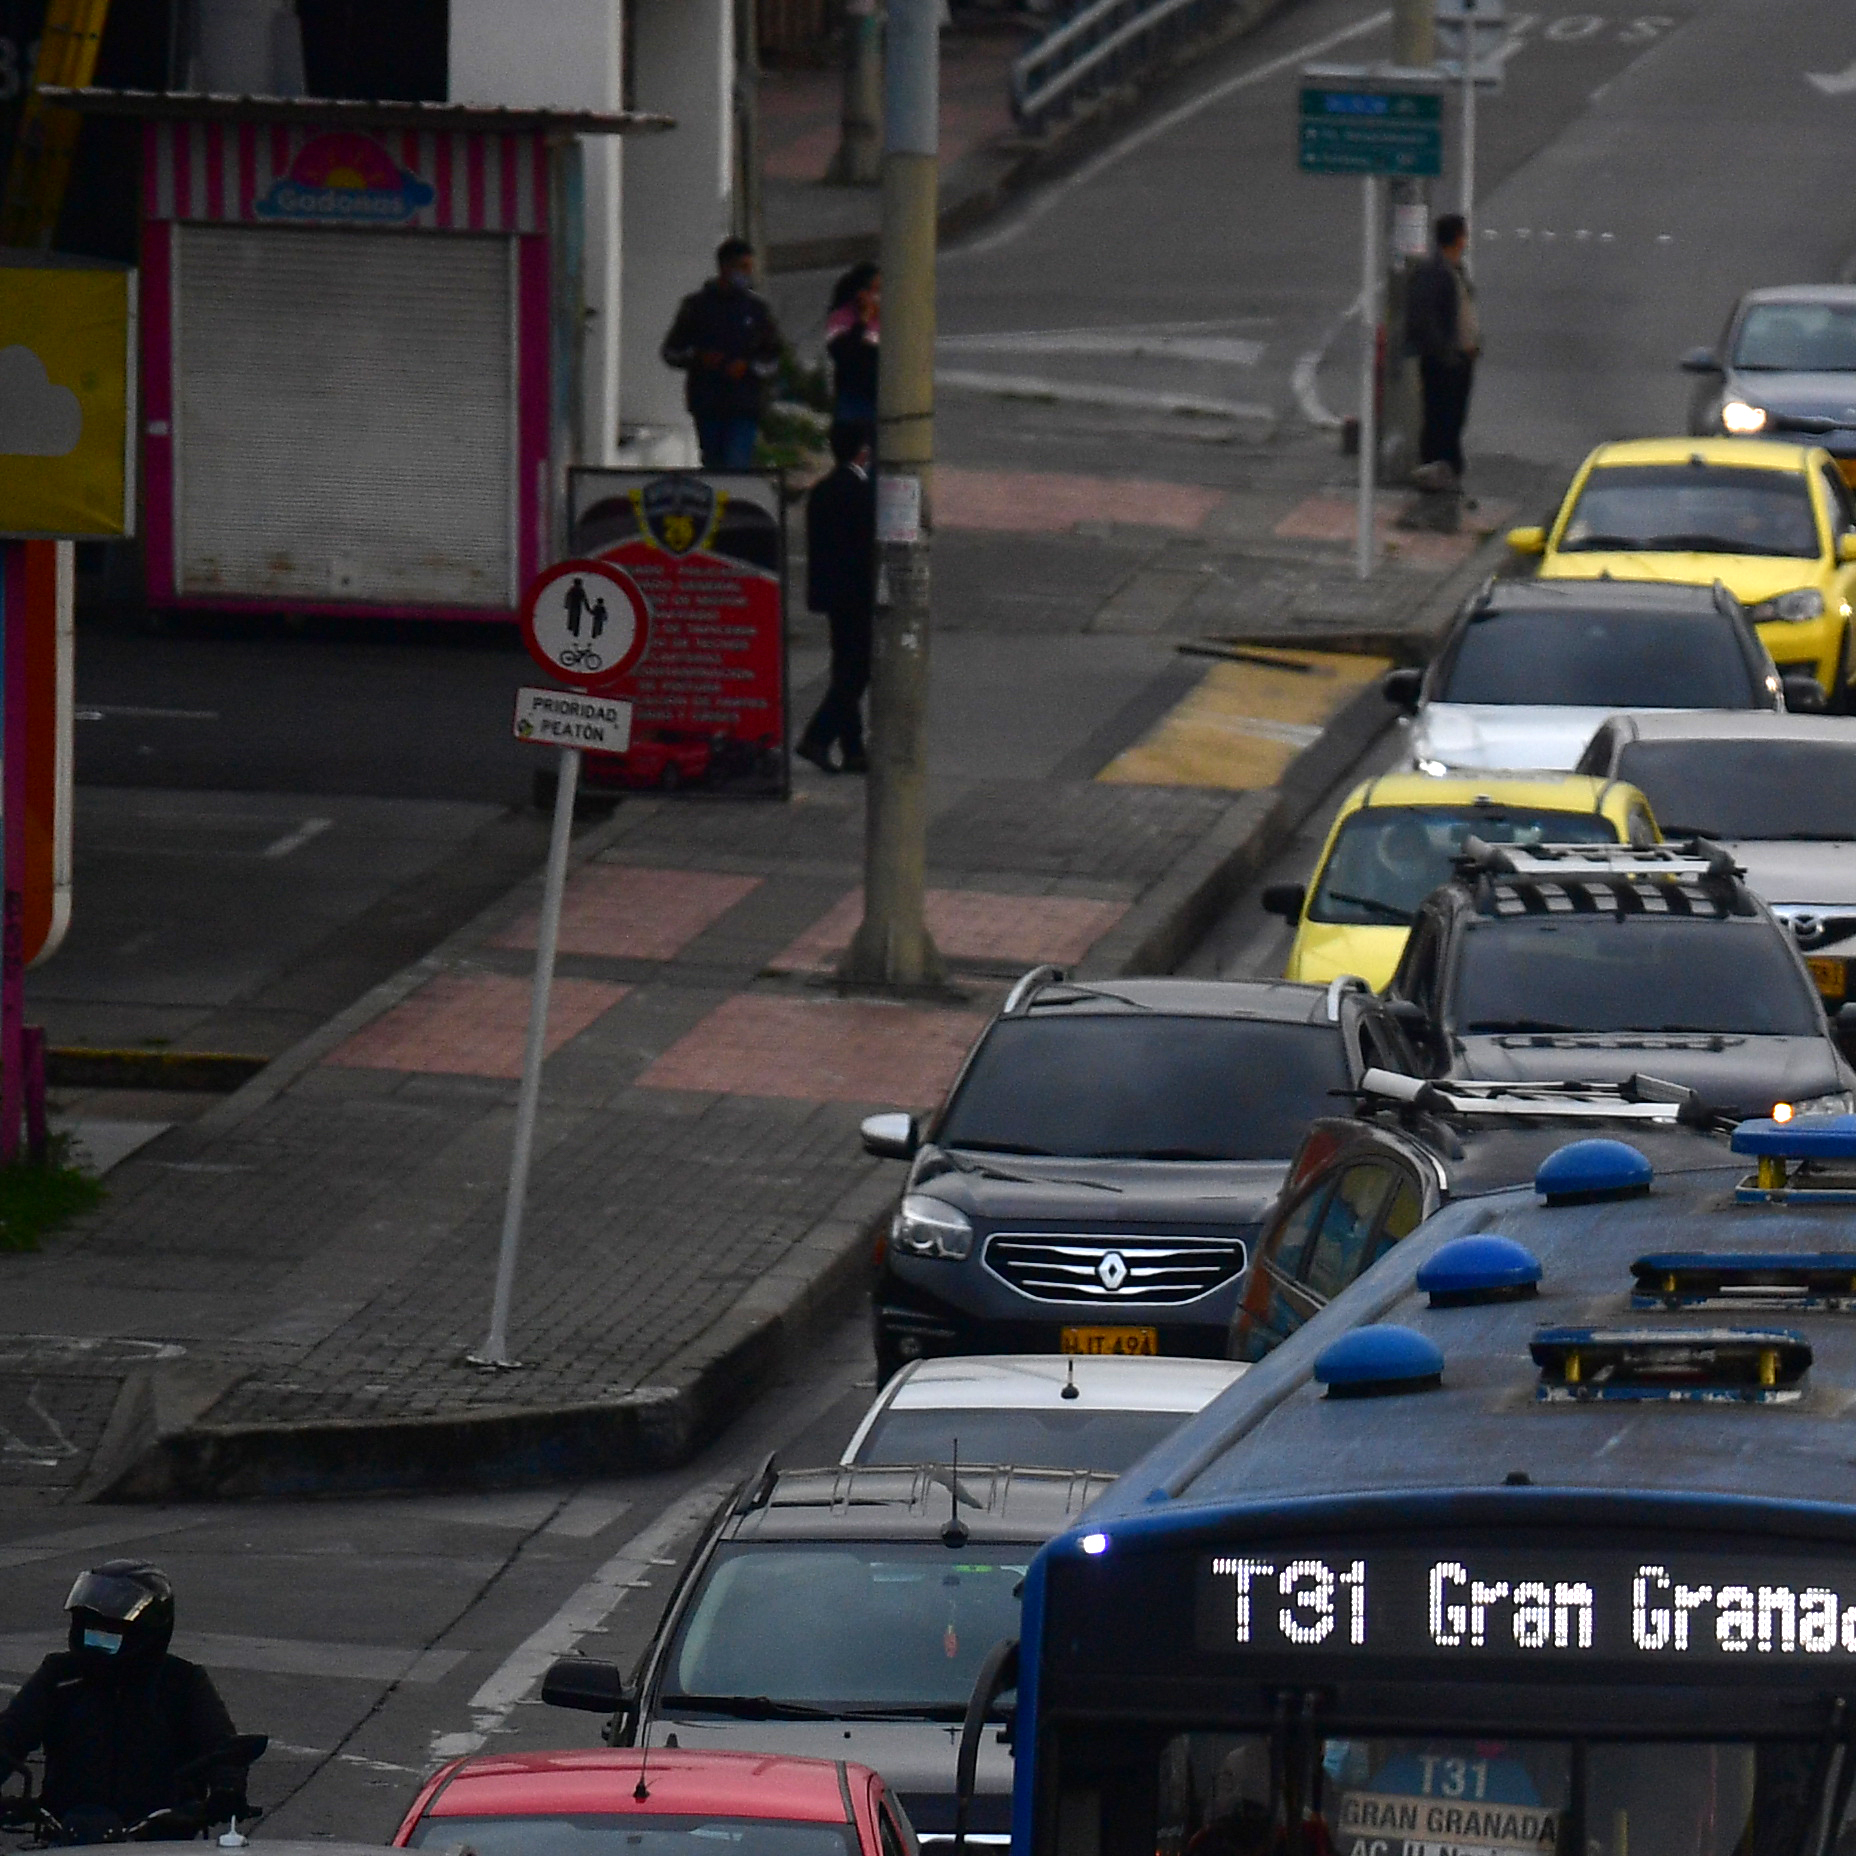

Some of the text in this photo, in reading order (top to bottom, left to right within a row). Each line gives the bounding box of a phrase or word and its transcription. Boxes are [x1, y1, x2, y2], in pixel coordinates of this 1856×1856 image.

[532, 696, 618, 722] PRIORIDAD
[1212, 1558, 1365, 1644] T31
[1430, 1561, 1594, 1648] Gran
[1421, 1755, 1488, 1799] T31
[1343, 1797, 1557, 1843] GRAN GRANADA
